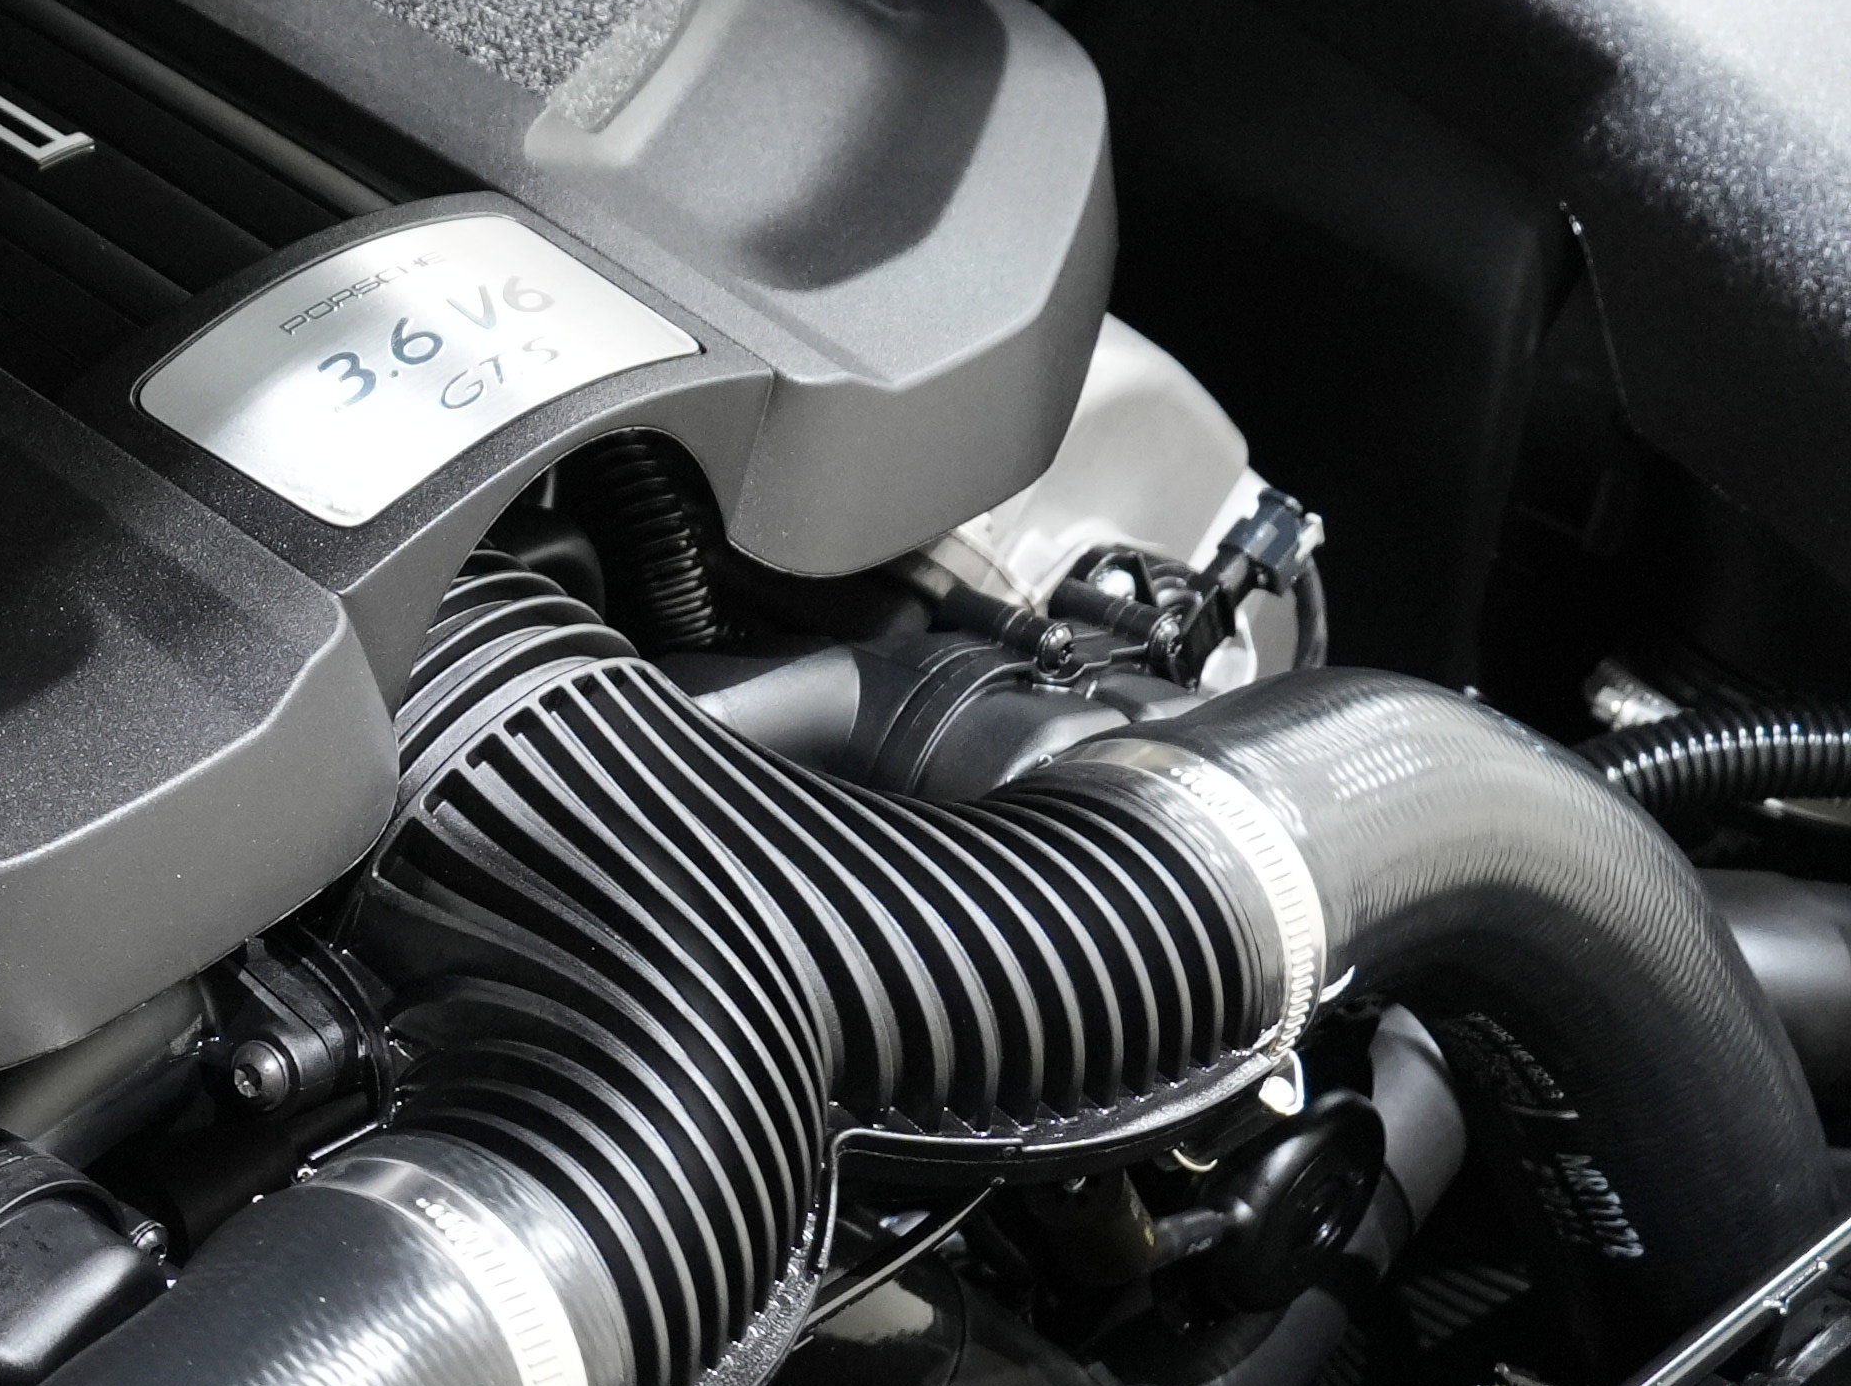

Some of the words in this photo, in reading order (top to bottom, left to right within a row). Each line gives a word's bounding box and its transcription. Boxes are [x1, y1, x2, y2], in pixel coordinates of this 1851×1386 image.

[278, 251, 447, 336] PORSCHE
[316, 316, 444, 414] 3.6
[446, 275, 557, 331] V6
[440, 335, 562, 411] GTS
